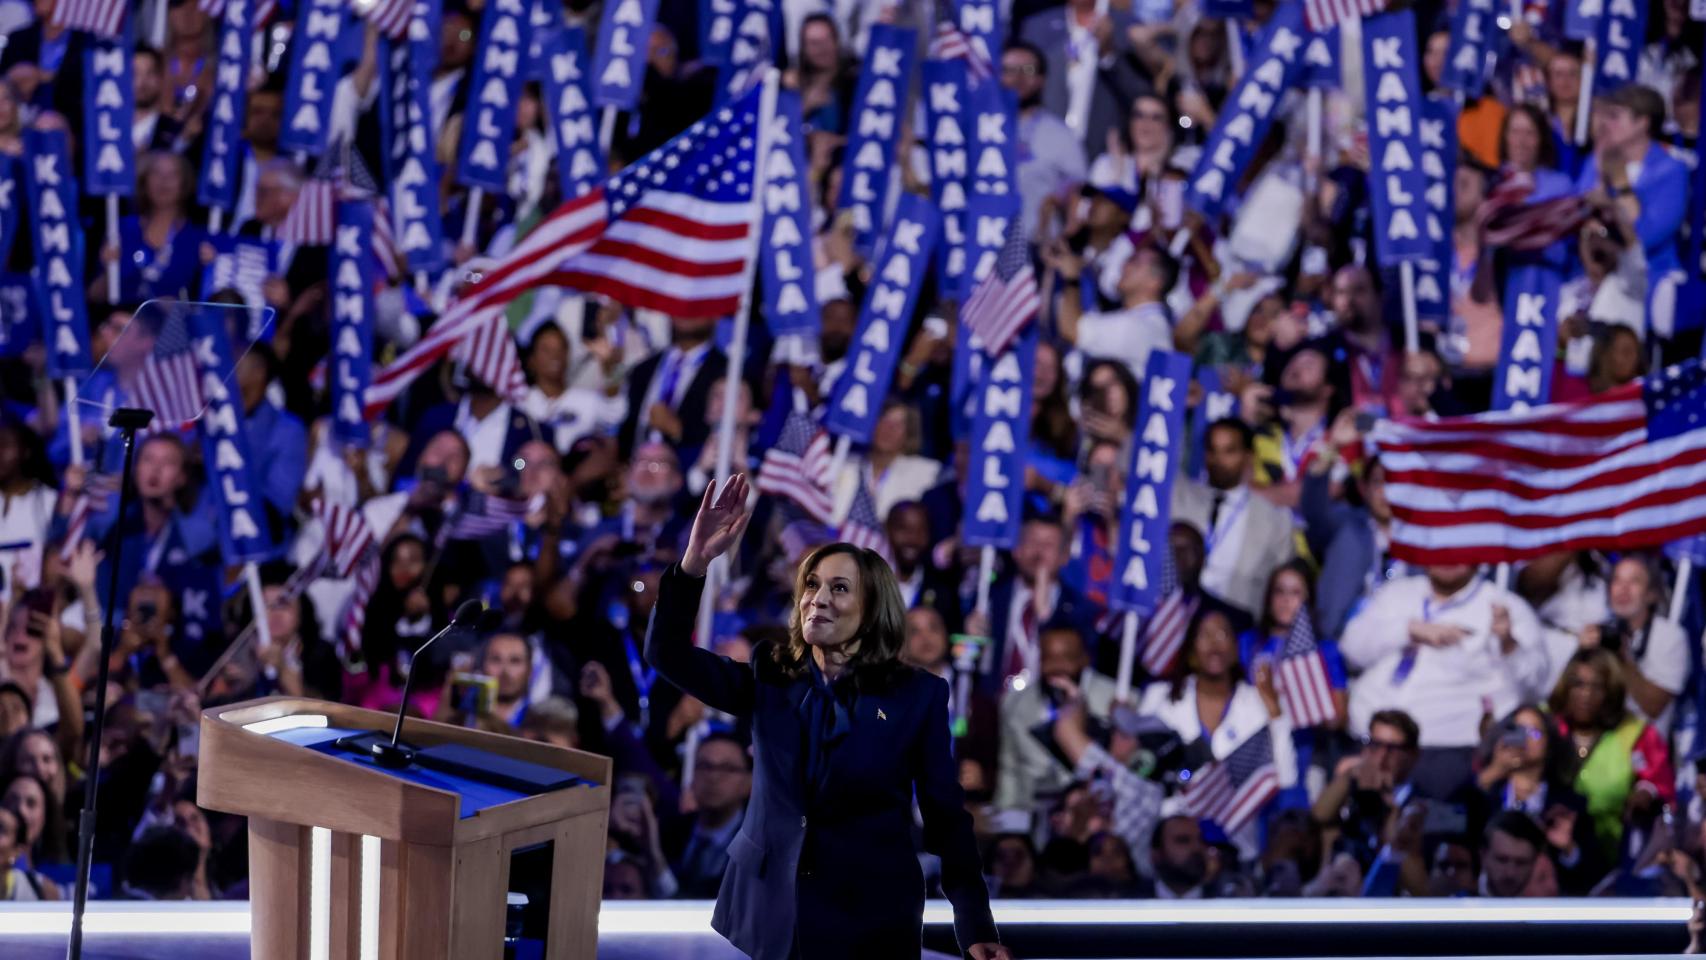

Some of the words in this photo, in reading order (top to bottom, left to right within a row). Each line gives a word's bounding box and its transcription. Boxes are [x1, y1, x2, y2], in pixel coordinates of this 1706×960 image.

[92, 46, 126, 174] MALA
[929, 82, 967, 278] KAMALA
[1192, 26, 1302, 202] KAMALA
[1372, 36, 1419, 242] KAMALA
[34, 153, 80, 356] KAMALA
[769, 115, 808, 316] KAMALA
[335, 225, 366, 424] KAMALA
[840, 219, 925, 420] KAMALA
[194, 334, 259, 539] KAMALA
[975, 352, 1022, 523] AMALA
[1120, 376, 1176, 591] KAMALA
